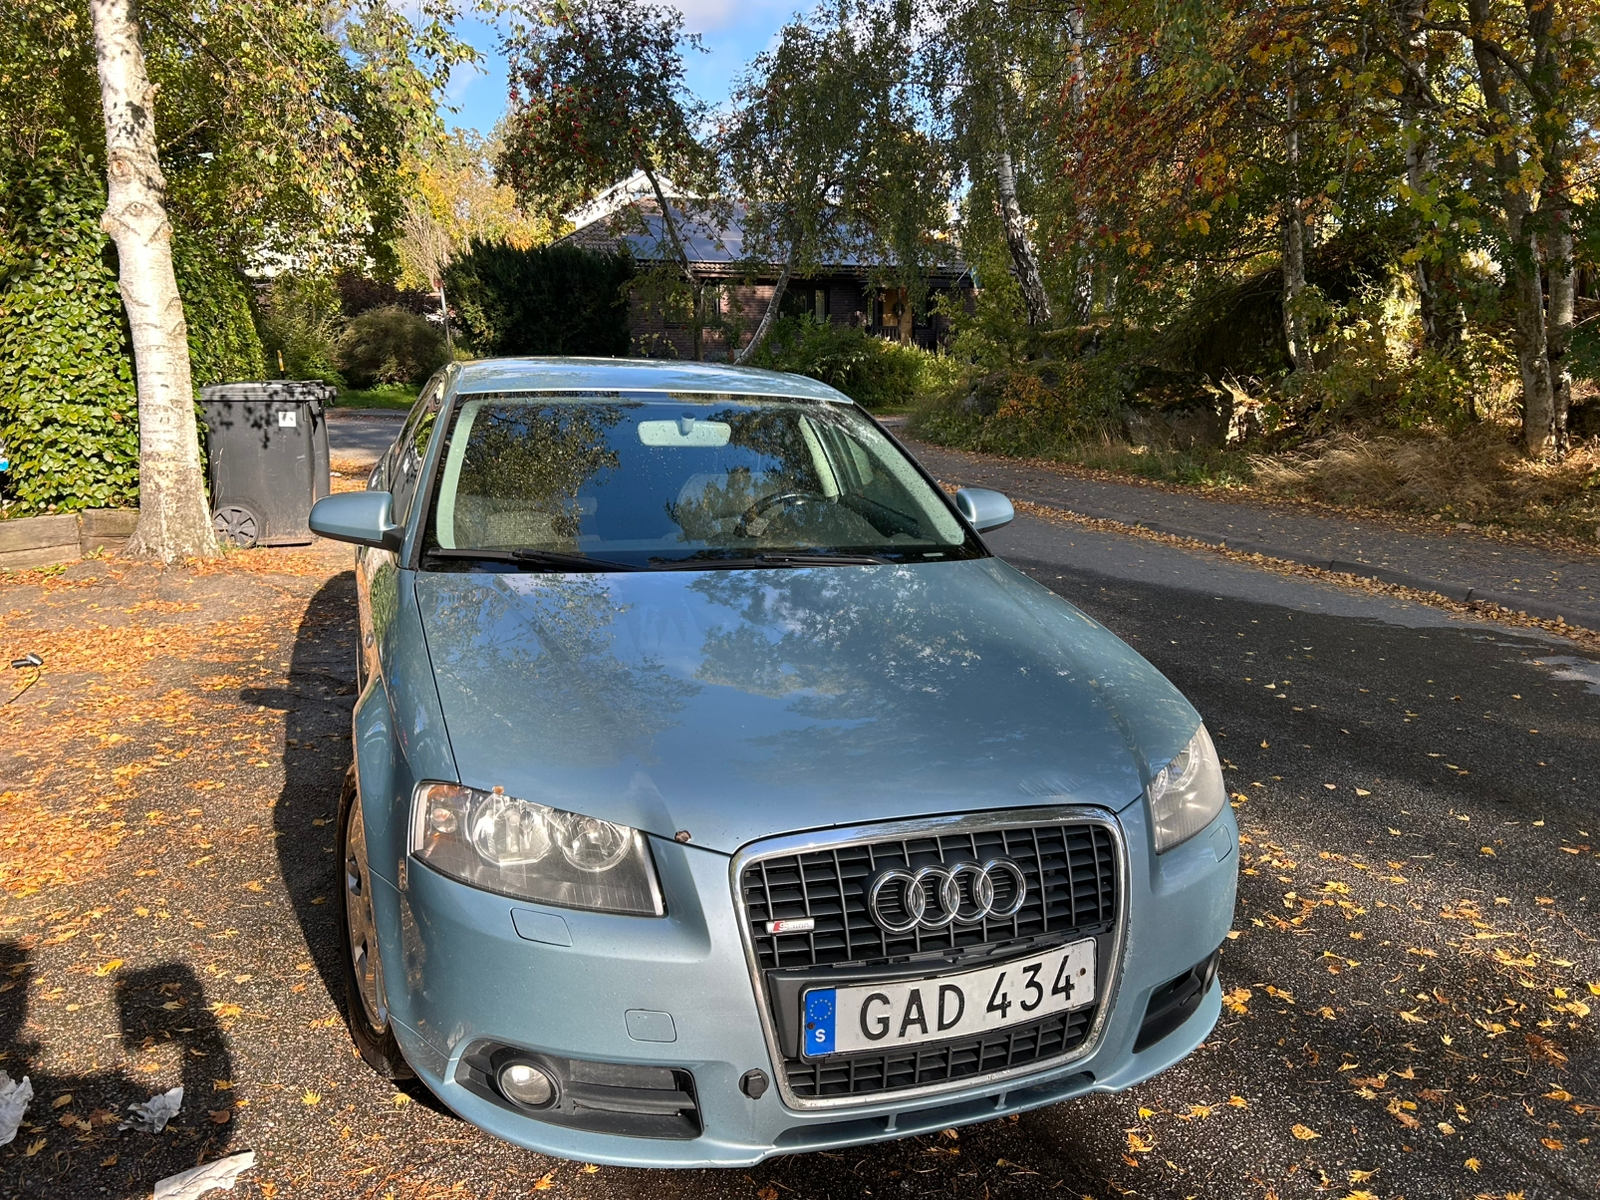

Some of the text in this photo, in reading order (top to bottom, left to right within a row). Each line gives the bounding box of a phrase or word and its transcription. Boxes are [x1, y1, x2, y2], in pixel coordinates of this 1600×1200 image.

[859, 955, 1076, 1041] GAD 434
[815, 1028, 826, 1042] S
